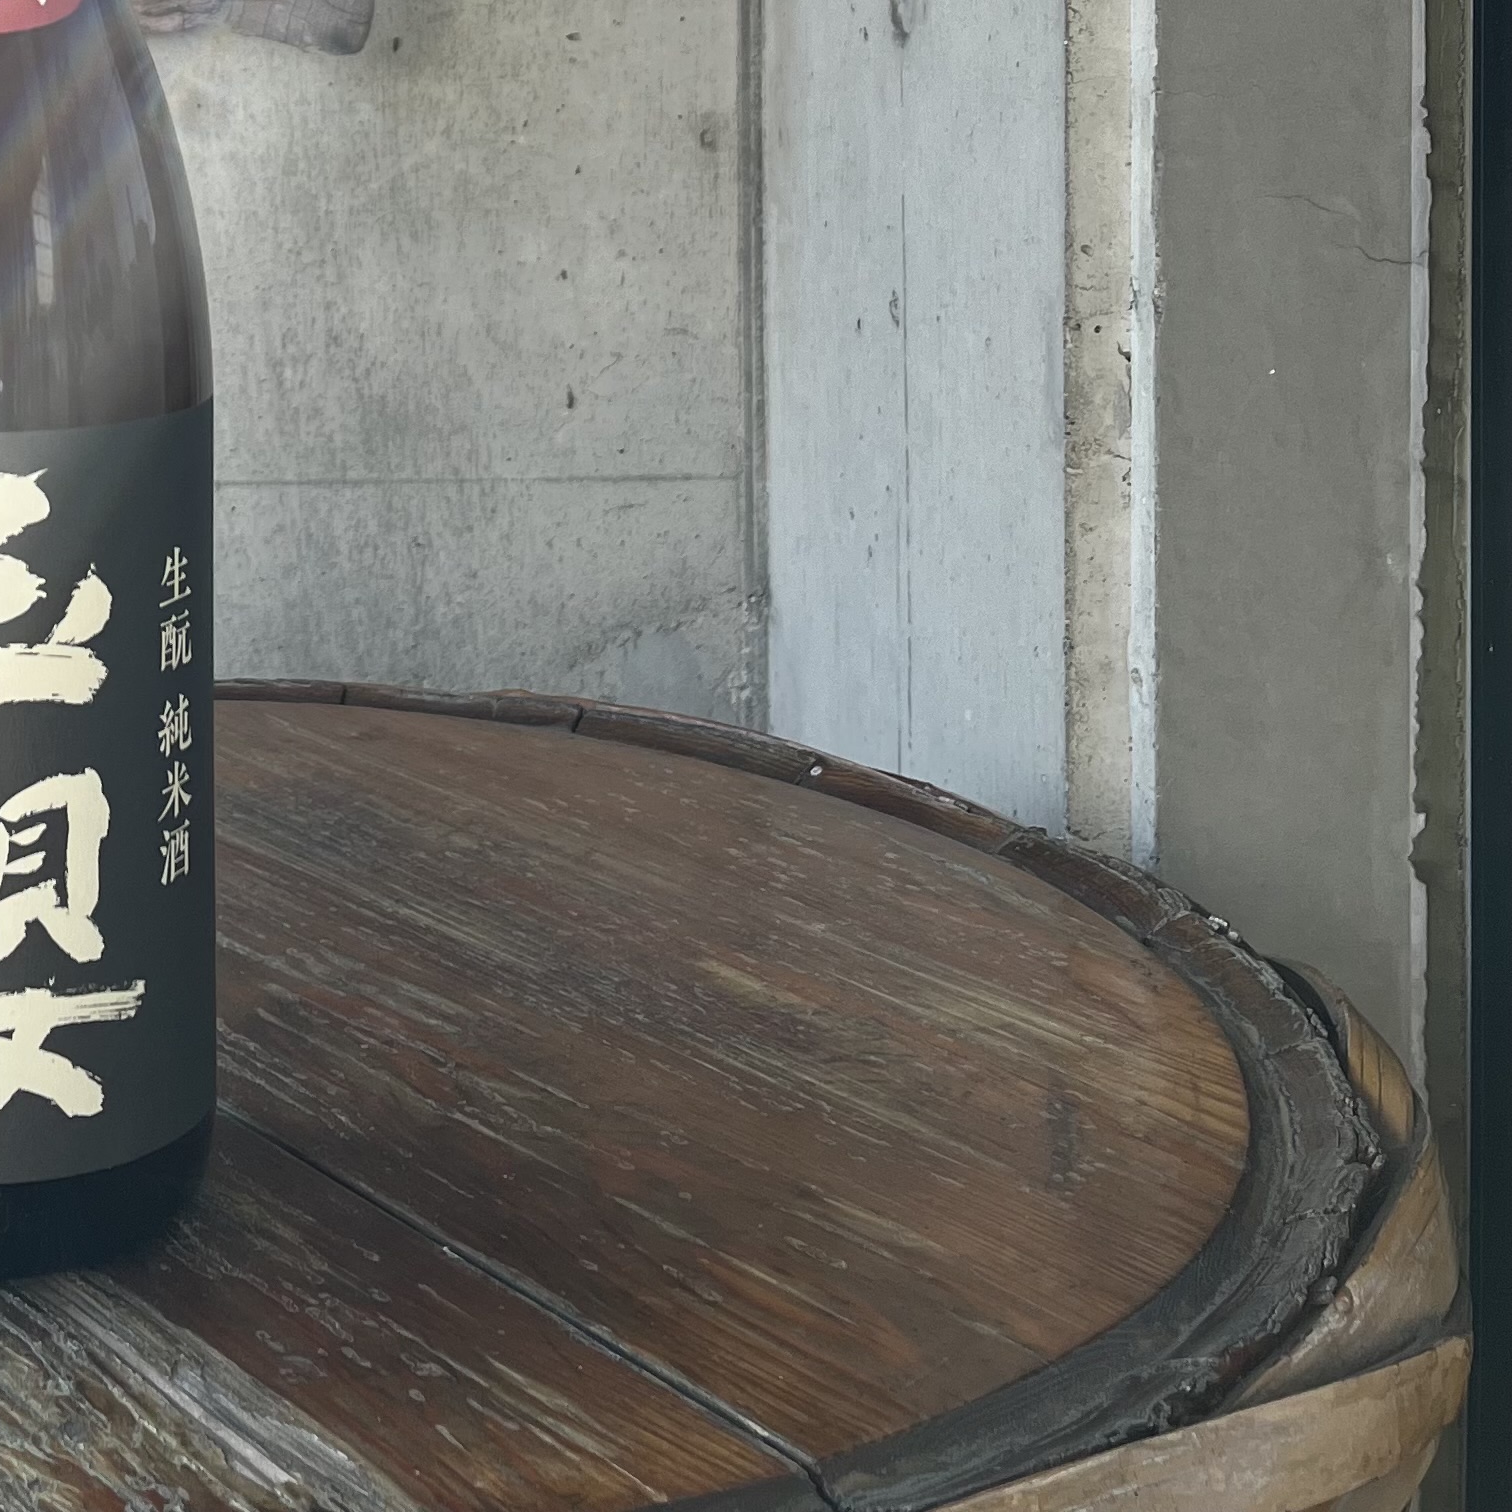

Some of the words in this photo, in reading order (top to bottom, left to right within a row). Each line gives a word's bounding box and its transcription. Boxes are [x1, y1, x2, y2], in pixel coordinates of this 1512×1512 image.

[159, 546, 192, 672] 生酛
[158, 693, 193, 886] 純米酒
